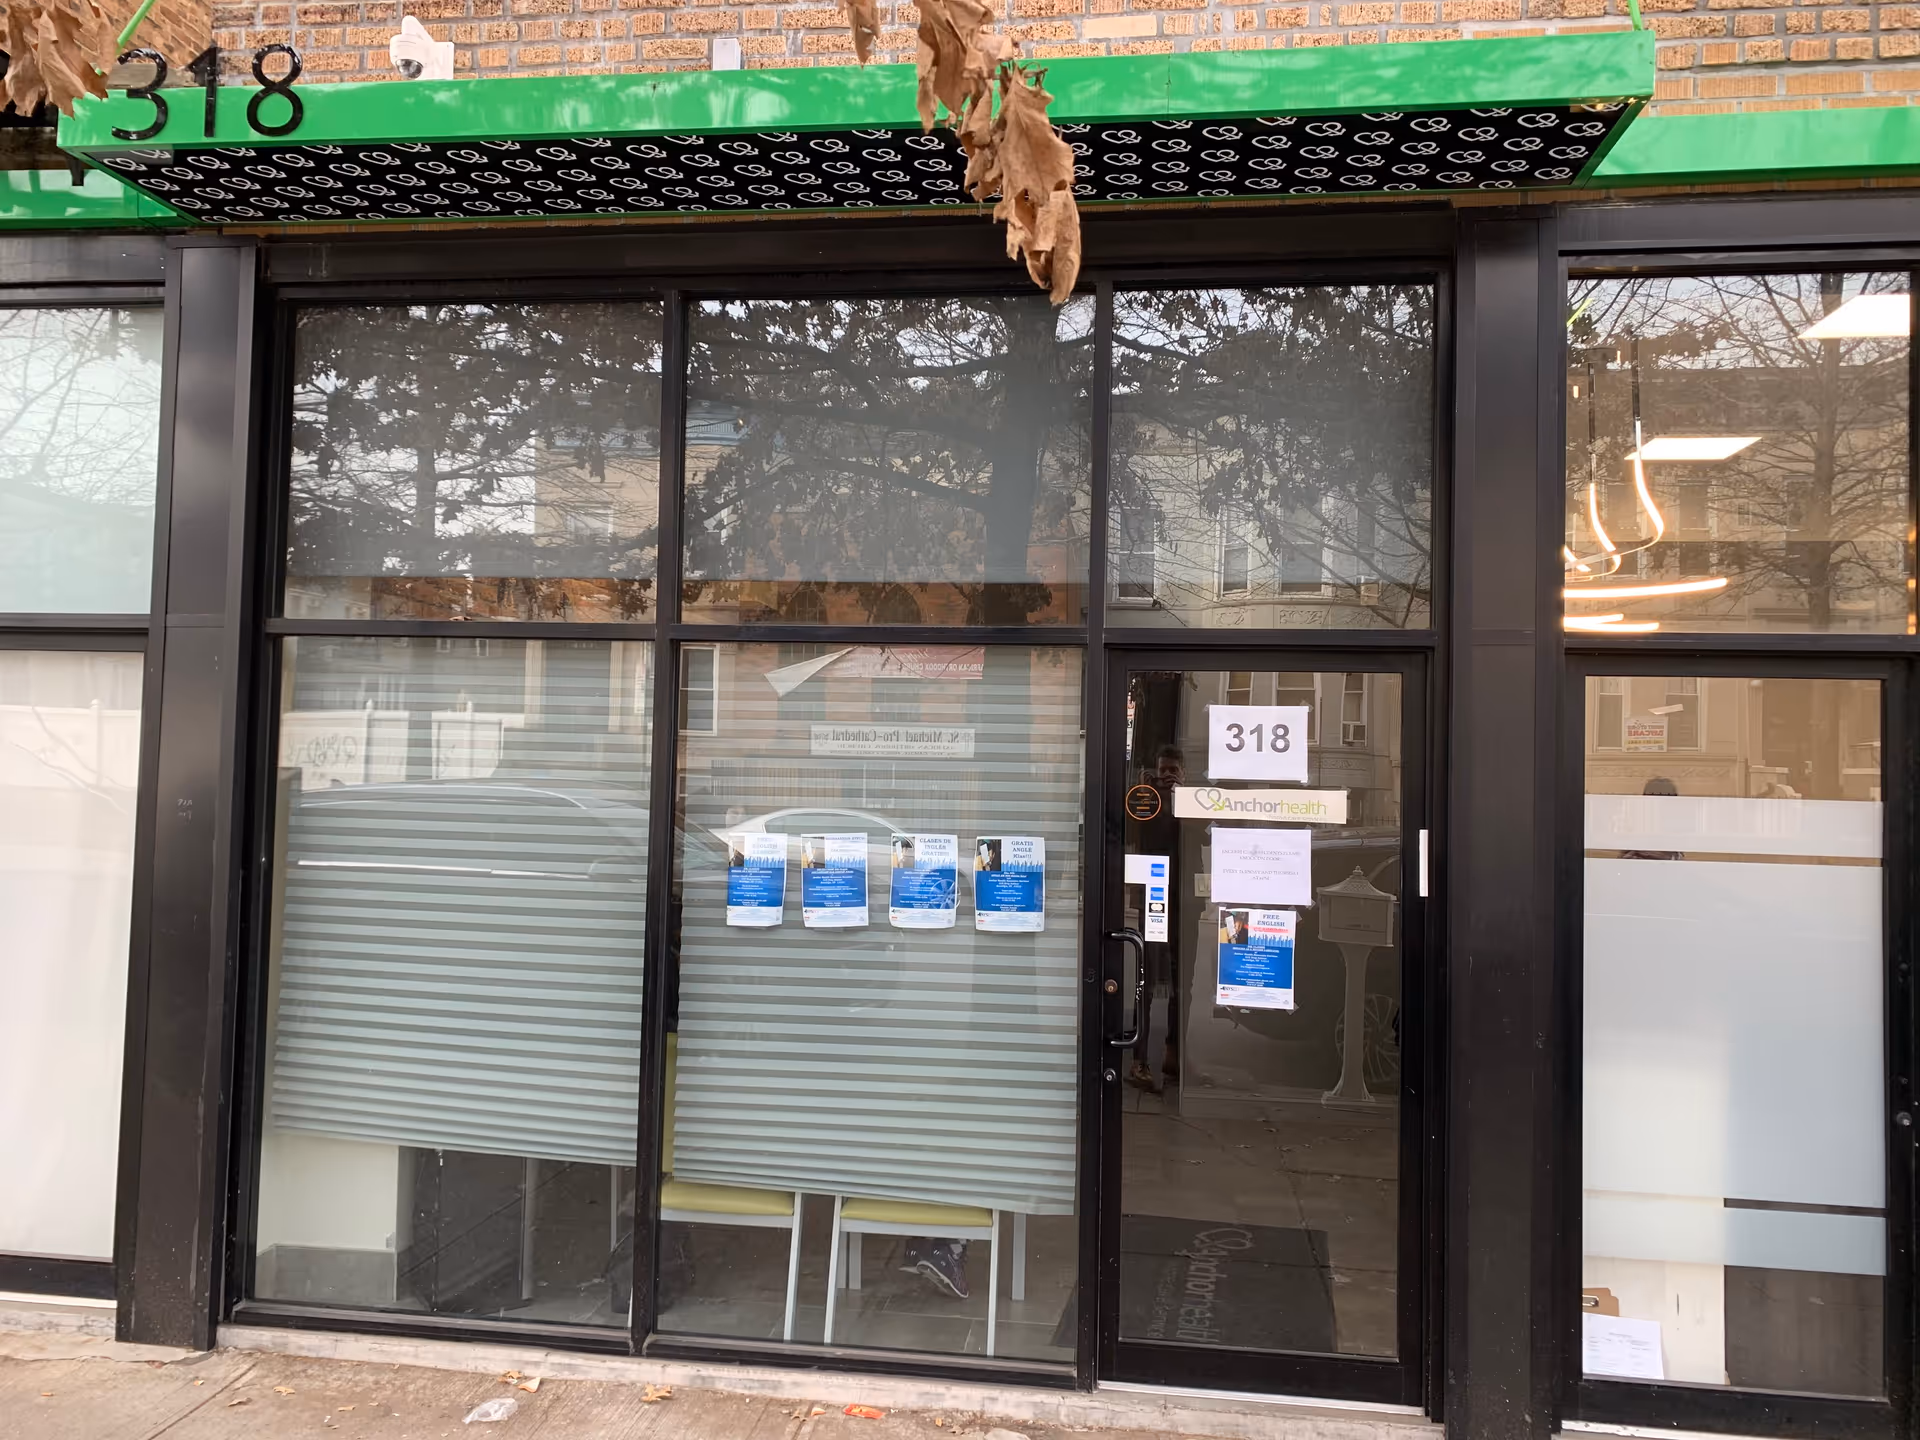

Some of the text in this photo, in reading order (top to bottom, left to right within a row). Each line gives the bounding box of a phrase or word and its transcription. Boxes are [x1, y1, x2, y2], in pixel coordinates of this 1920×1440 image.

[111, 43, 304, 140] 318
[1225, 723, 1291, 753] 318
[1223, 796, 1327, 816] Anchorhealth
[1257, 920, 1286, 928] ENGLISH
